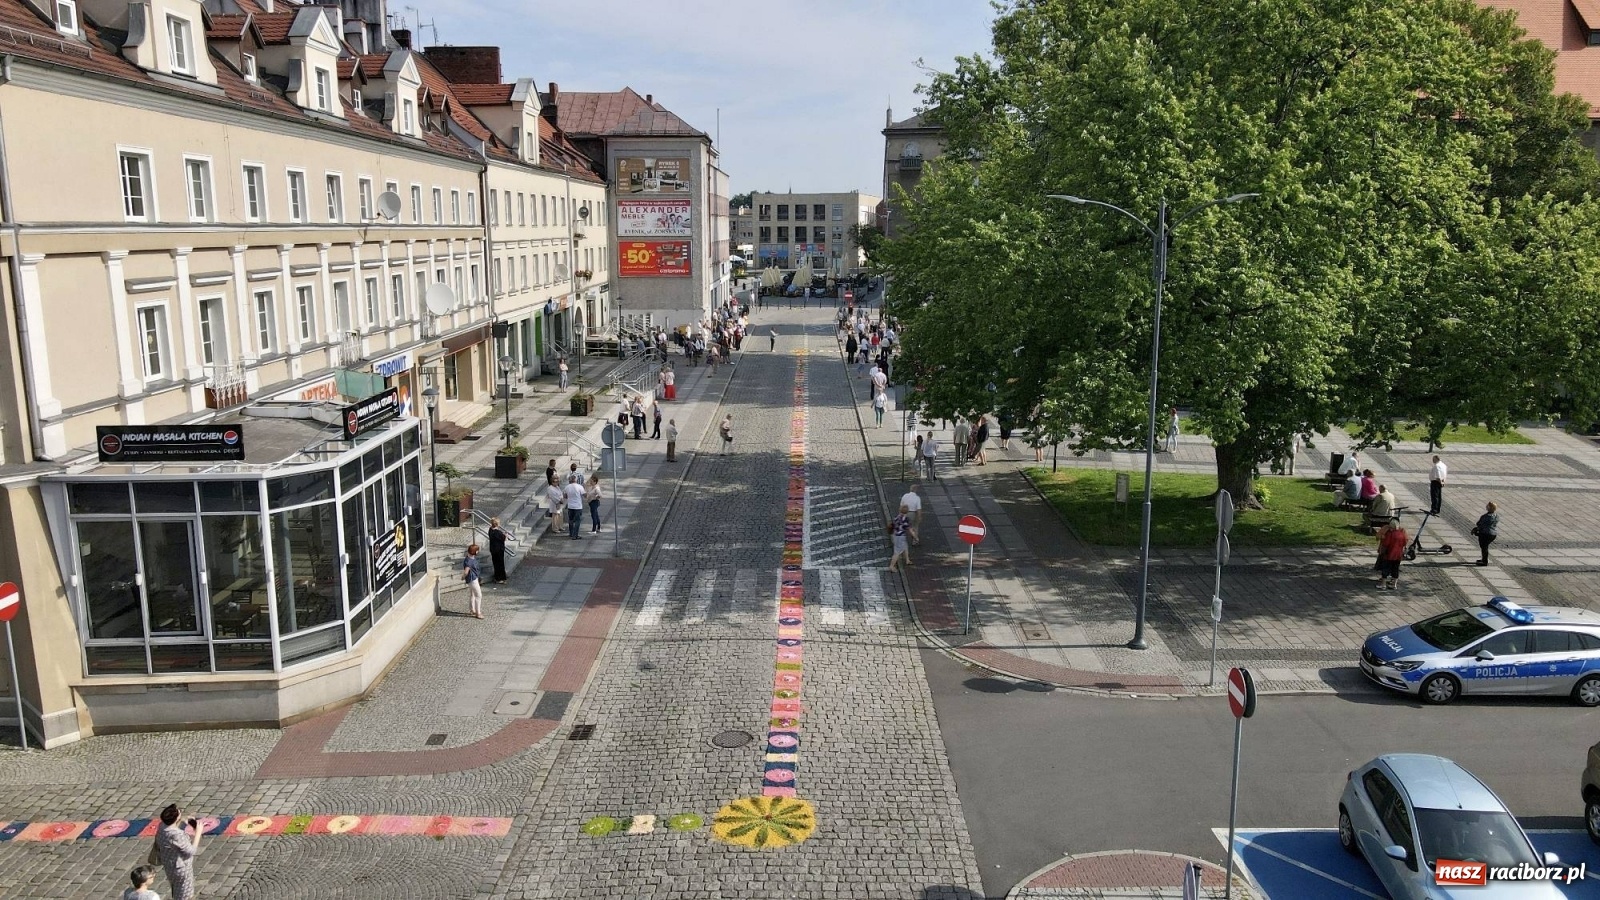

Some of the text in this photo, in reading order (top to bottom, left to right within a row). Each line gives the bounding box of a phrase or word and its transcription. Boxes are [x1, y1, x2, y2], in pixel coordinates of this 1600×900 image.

[621, 206, 688, 214] ALEXANDER
[378, 355, 407, 376] ZDROWIT
[301, 381, 337, 400] APTEKA
[121, 432, 223, 442] INDIAN MASALA KITCHEN
[1378, 635, 1404, 653] POLICJA
[1475, 666, 1518, 677] POLICJA
